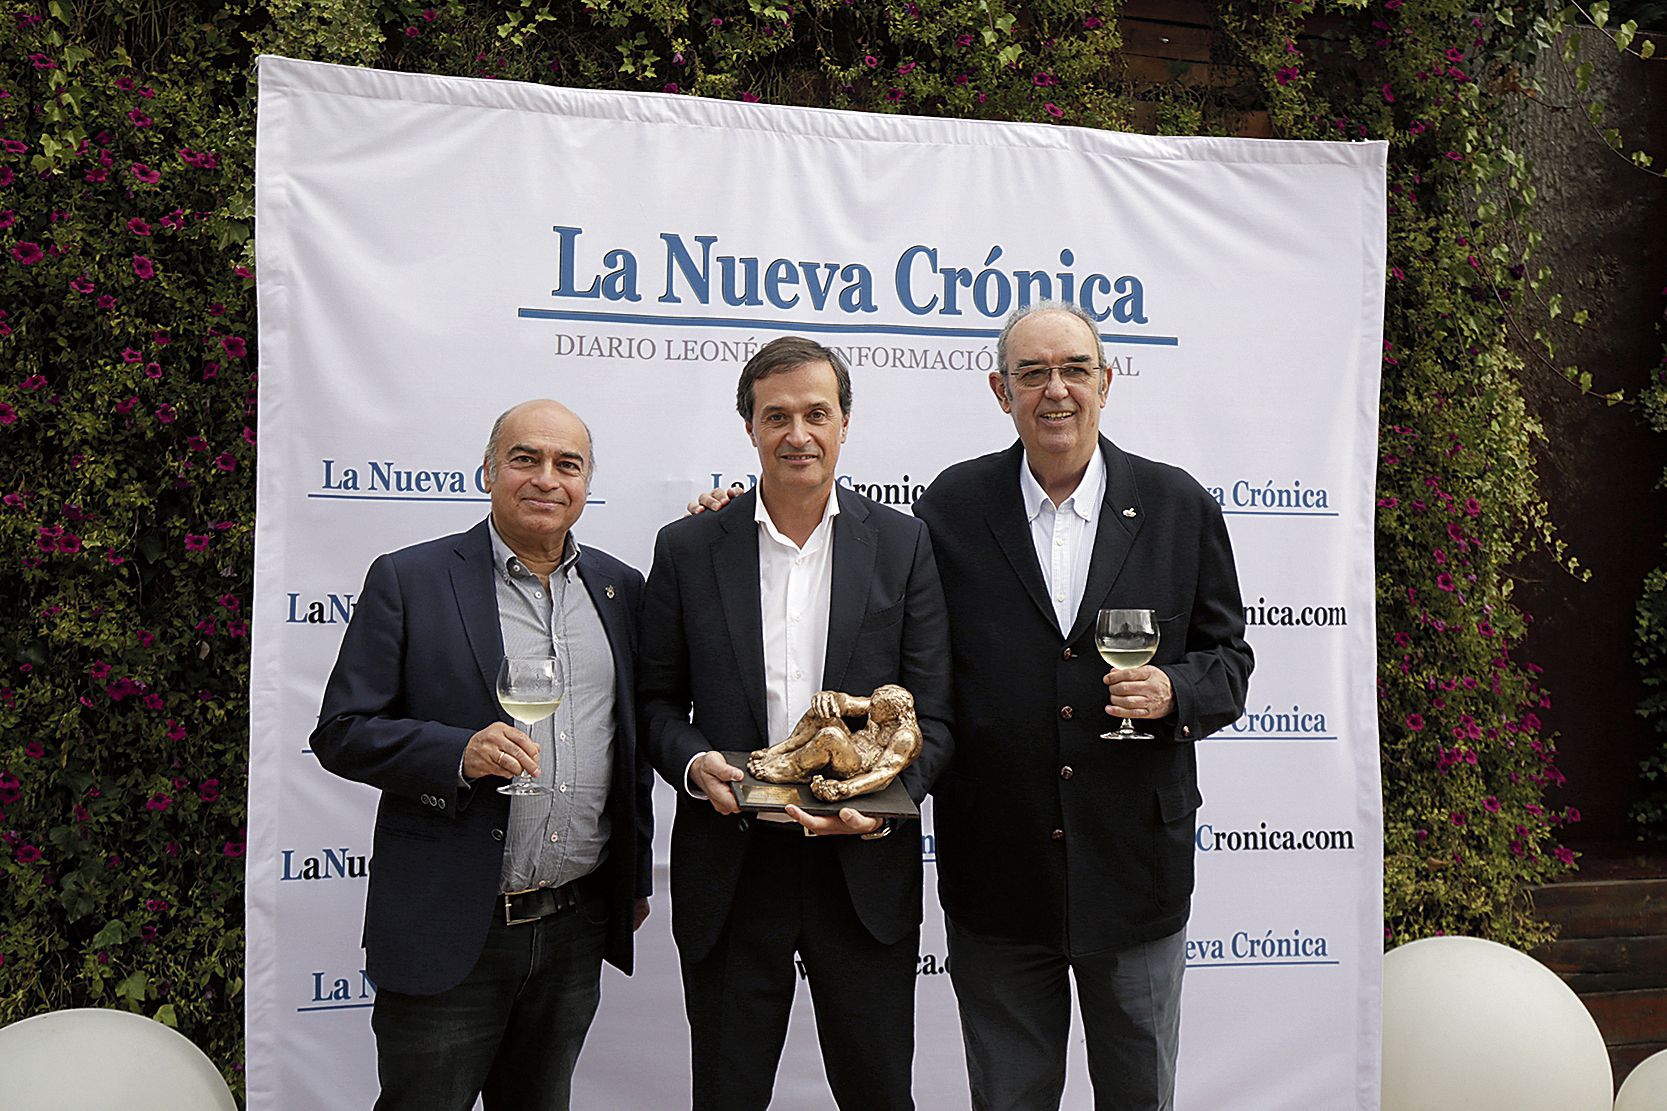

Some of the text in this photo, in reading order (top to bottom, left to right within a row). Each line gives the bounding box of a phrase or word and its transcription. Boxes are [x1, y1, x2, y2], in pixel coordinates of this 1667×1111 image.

[551, 225, 1149, 324] La Nueva Crónica
[555, 334, 656, 358] DIARIO
[322, 460, 359, 490] La
[368, 462, 466, 493] Nueva
[1232, 480, 1328, 508] Crónica
[1196, 822, 1354, 851] Cronica.com
[1231, 929, 1328, 959] Crónica
[312, 972, 350, 1001] La
